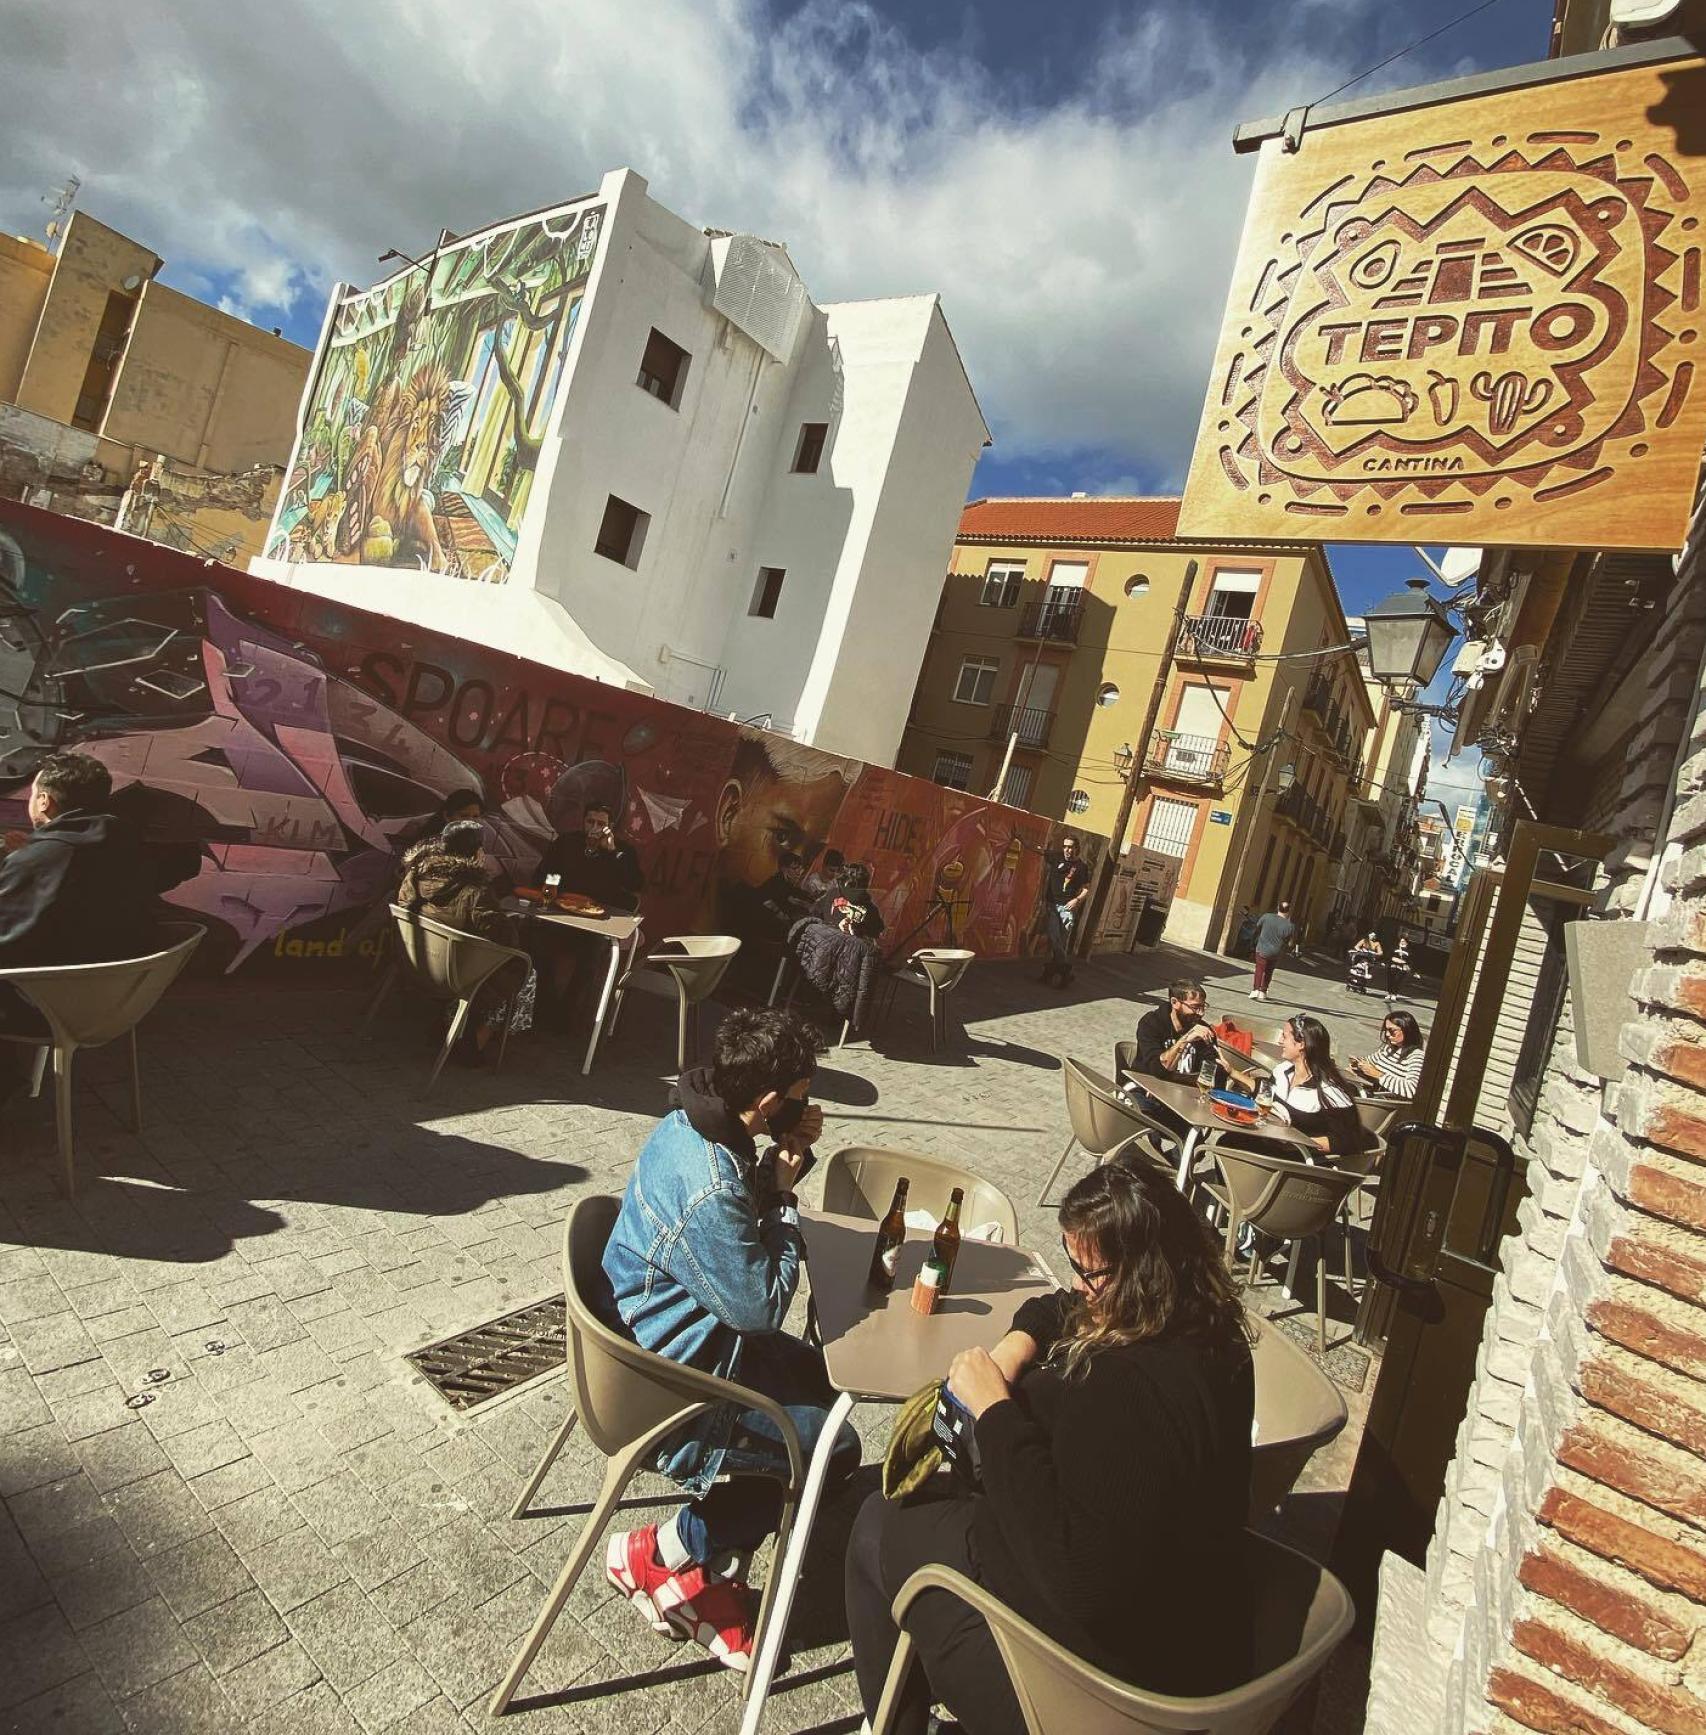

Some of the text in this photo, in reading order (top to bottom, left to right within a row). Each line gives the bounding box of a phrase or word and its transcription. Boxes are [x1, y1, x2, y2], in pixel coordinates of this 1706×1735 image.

[1317, 302, 1595, 364] TEPITO
[1362, 456, 1465, 473] CANTINA
[274, 926, 347, 958] land
